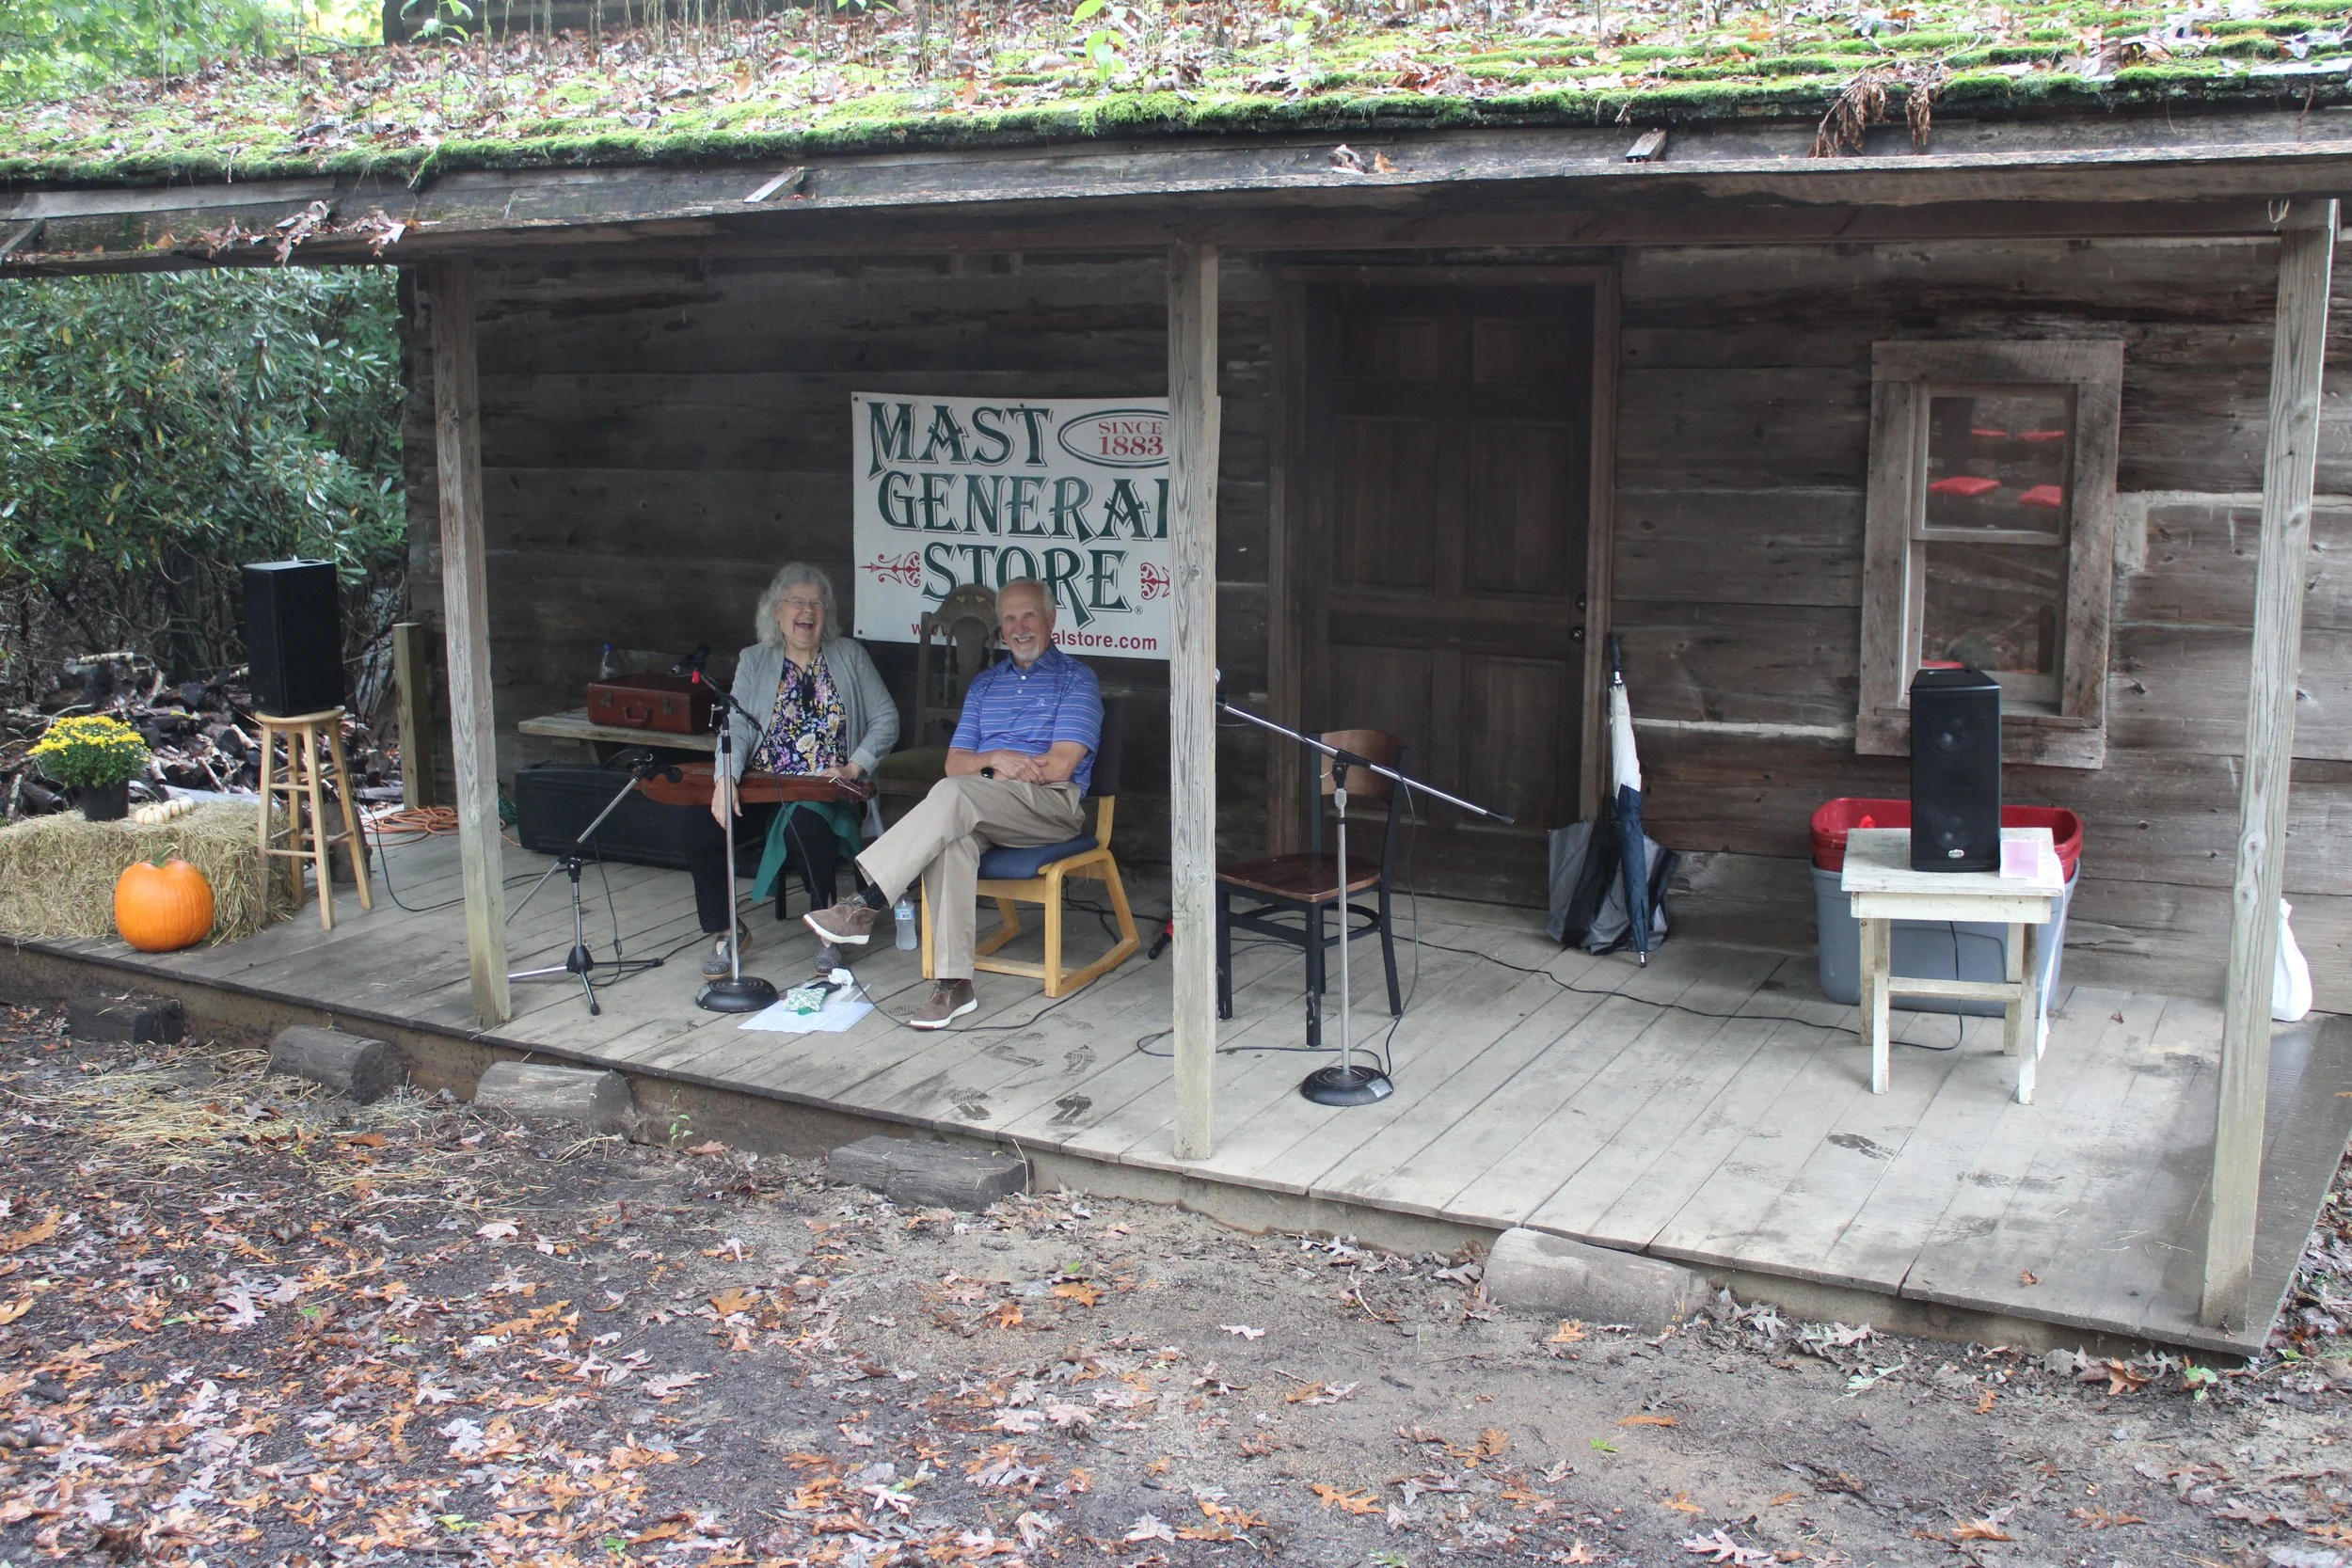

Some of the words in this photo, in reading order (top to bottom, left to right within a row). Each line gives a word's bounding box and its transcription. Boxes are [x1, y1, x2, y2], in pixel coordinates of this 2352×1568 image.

[1098, 420, 1164, 436] SINCE
[866, 402, 1054, 481] MAST
[1098, 436, 1164, 456] 1883
